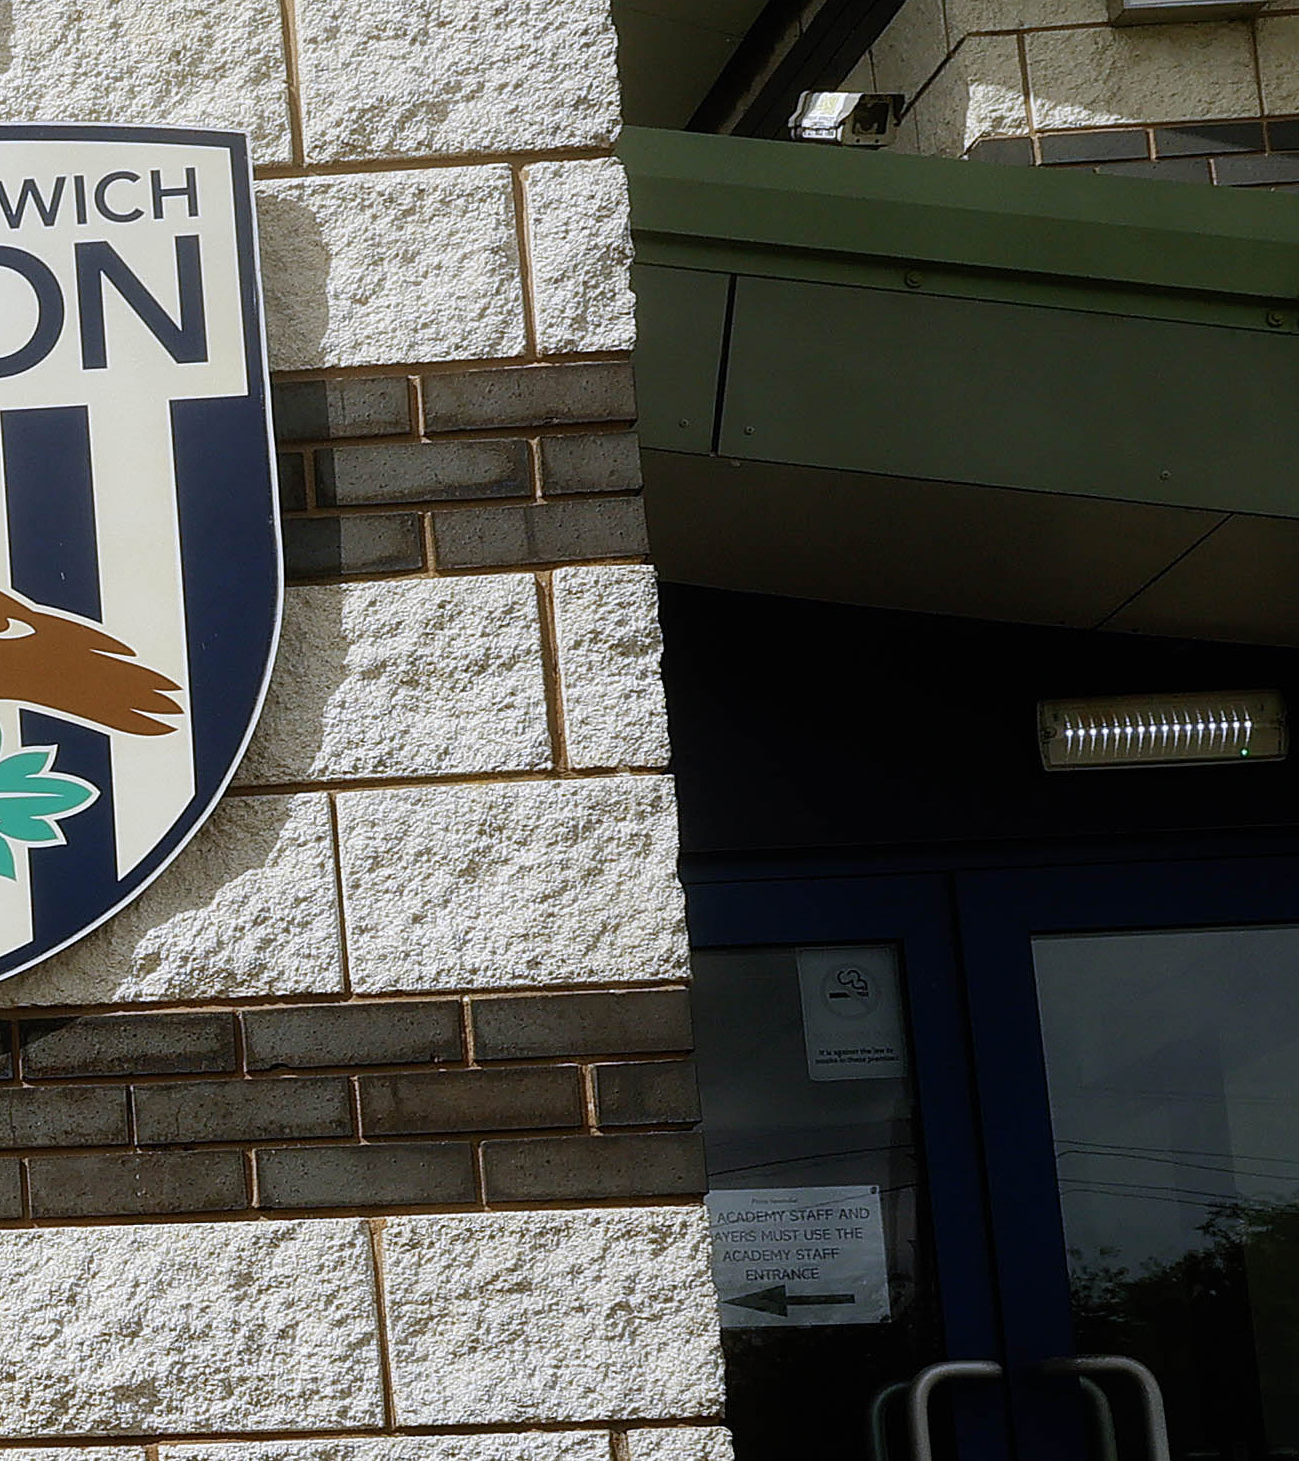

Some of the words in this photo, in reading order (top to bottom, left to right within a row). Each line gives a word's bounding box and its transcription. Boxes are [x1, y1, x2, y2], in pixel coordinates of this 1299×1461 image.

[717, 1211, 789, 1224] ACADEMY
[789, 1208, 834, 1222] STAFF
[838, 1207, 870, 1220] AND
[713, 1229, 757, 1243] AYERS
[761, 1229, 800, 1242] MUST
[804, 1228, 831, 1241] USE
[836, 1227, 863, 1240] THE
[722, 1249, 792, 1263] ACADEMY
[797, 1247, 840, 1261] STAFF
[746, 1267, 820, 1281] ENTRANCE
